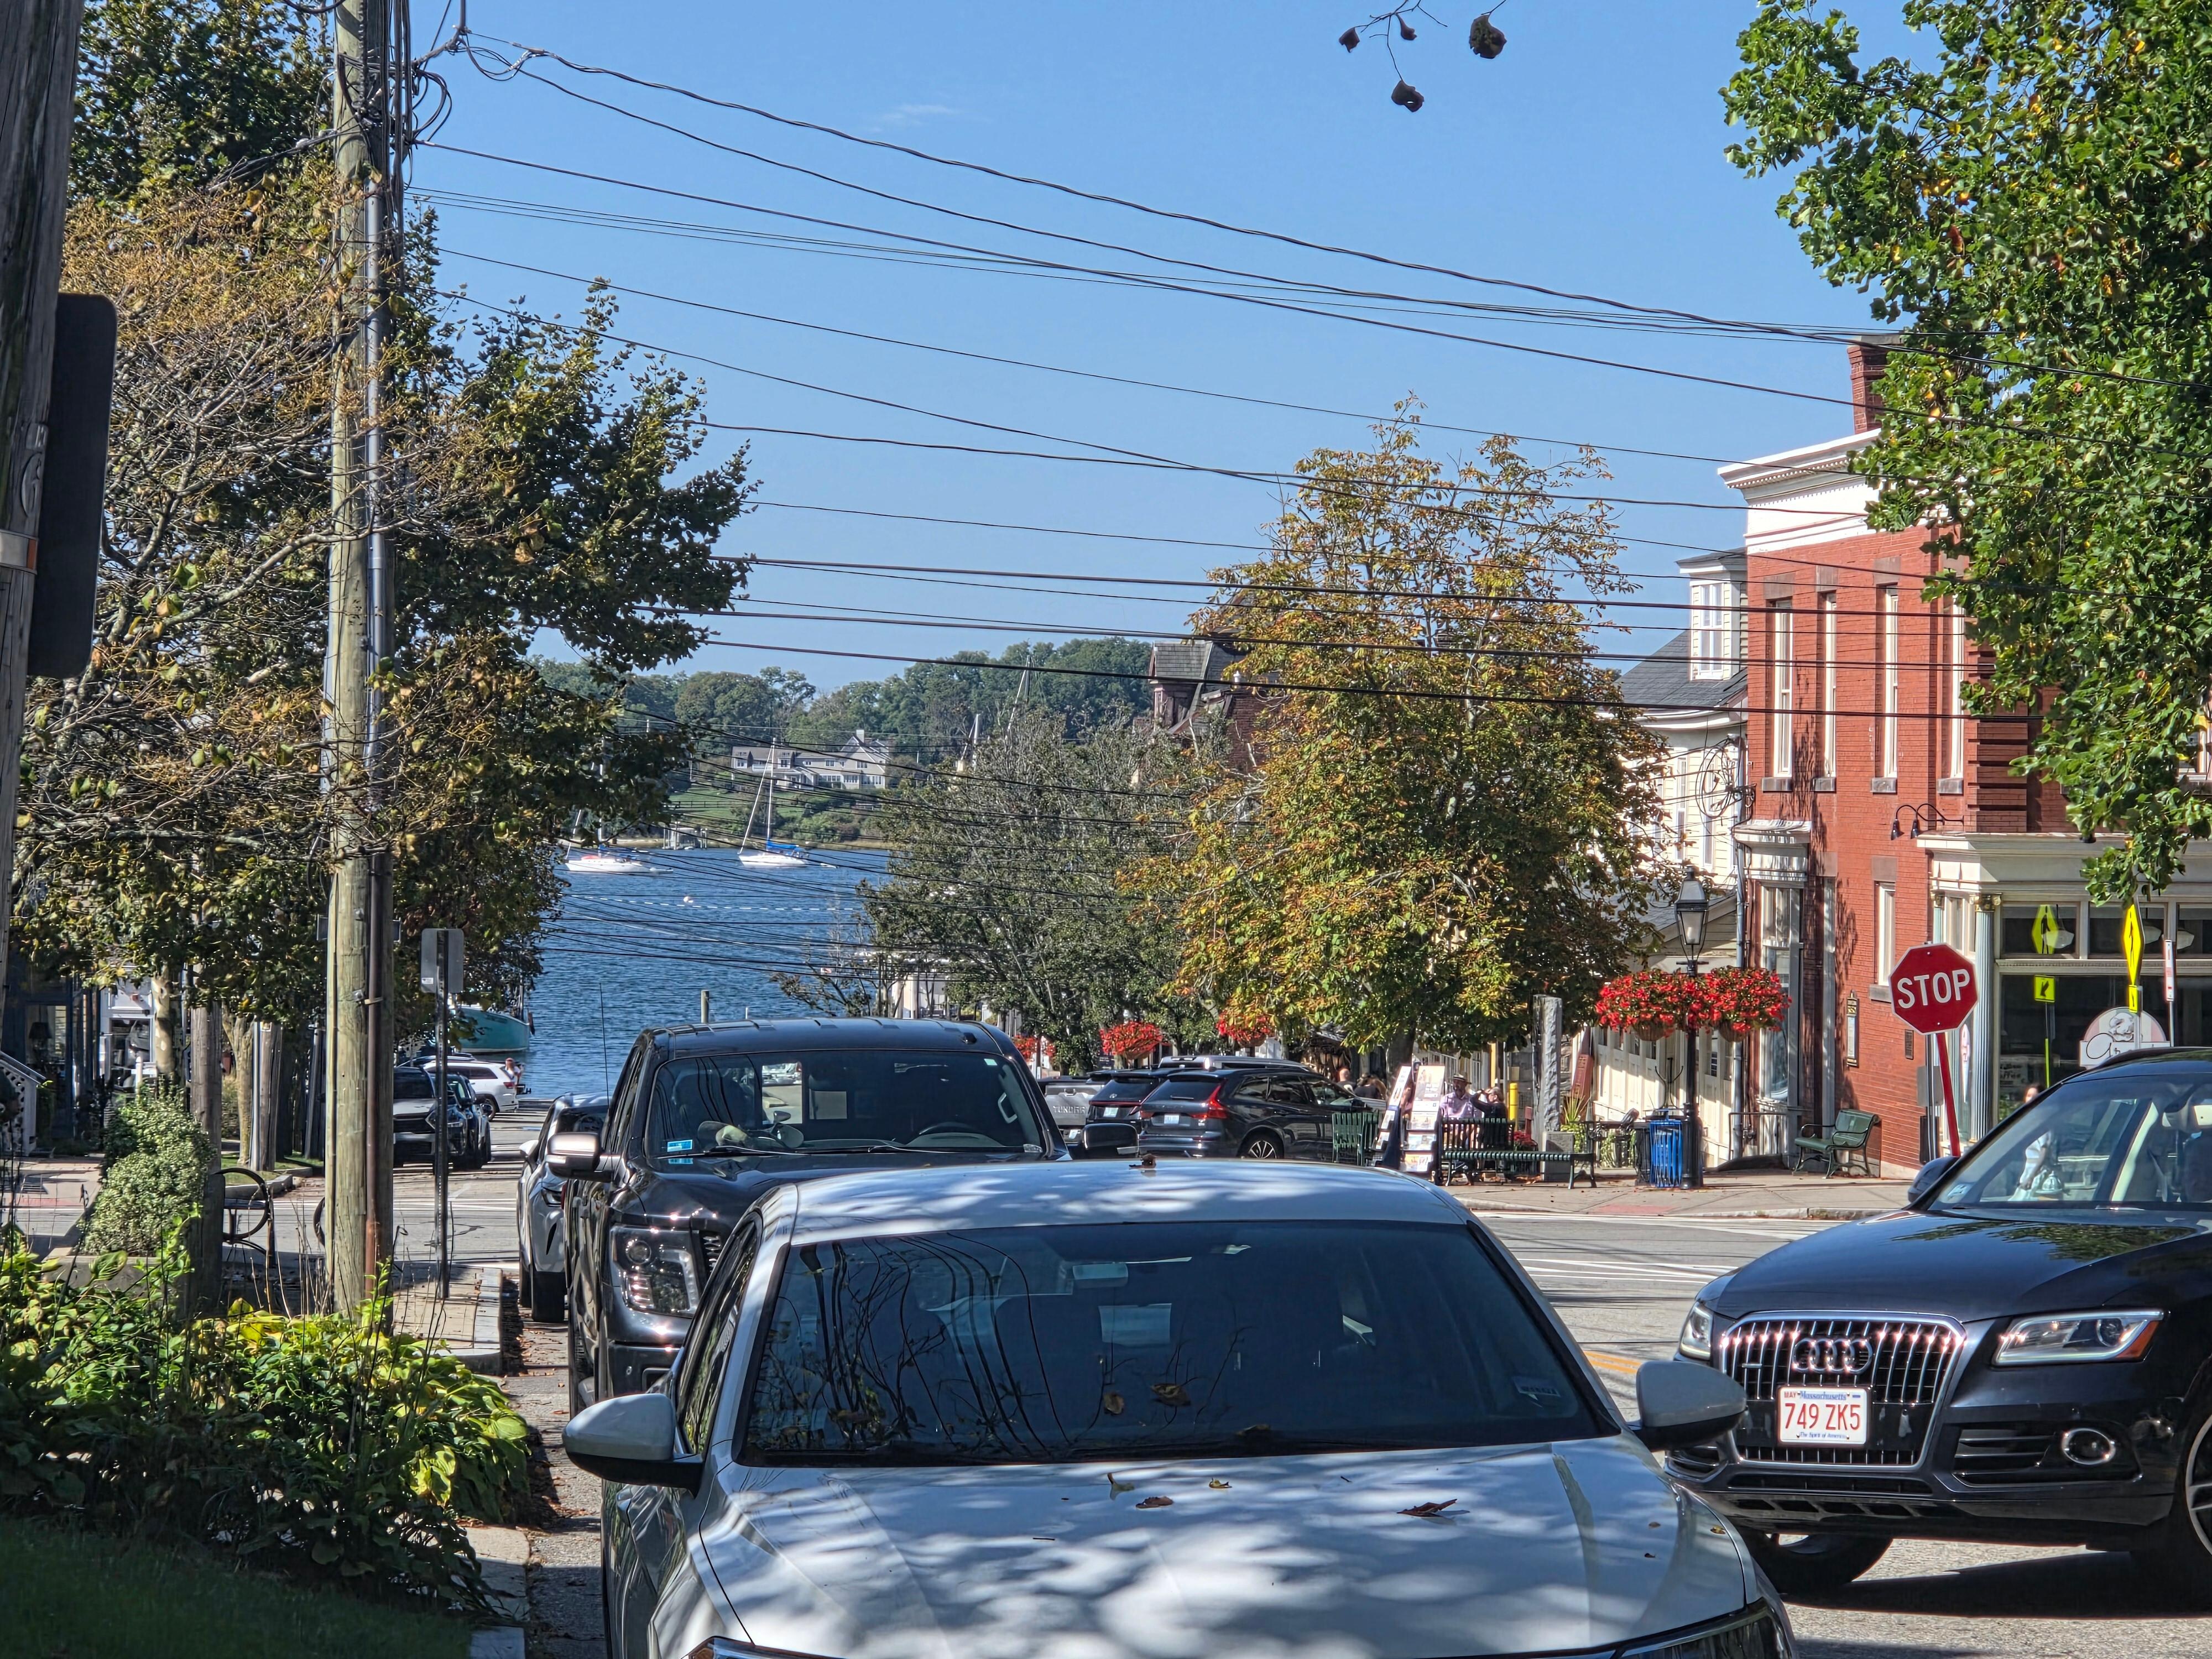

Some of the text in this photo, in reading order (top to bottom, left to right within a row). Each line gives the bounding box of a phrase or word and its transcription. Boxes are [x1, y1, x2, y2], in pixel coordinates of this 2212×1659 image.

[1897, 969, 1970, 1009] STOP
[1800, 1391, 1846, 1400] Massachusetts
[1785, 1403, 1860, 1431] 749 ZK5
